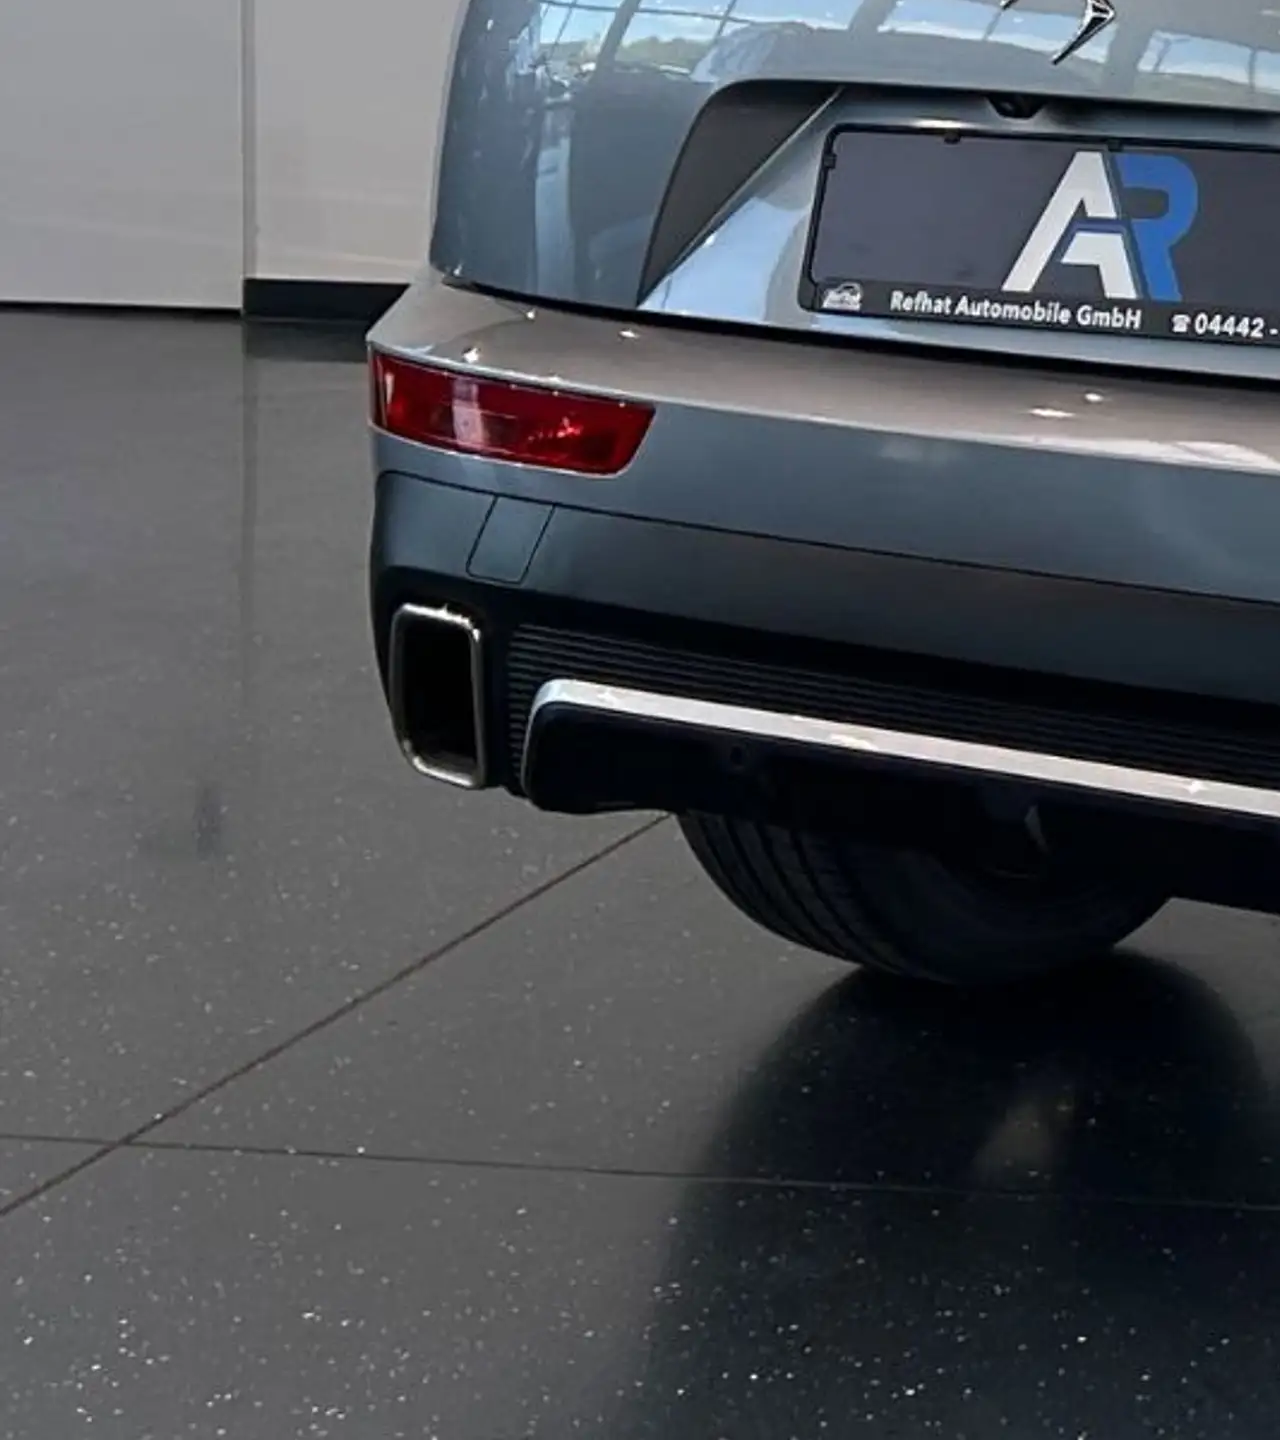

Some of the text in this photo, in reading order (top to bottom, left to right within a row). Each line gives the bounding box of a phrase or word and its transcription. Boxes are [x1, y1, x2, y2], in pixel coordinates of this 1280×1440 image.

[1001, 150, 1199, 303] AR
[889, 290, 952, 315] Refhat
[954, 295, 1072, 324] Automobile
[1075, 304, 1143, 330] GmbH
[1194, 312, 1265, 339] 04442
